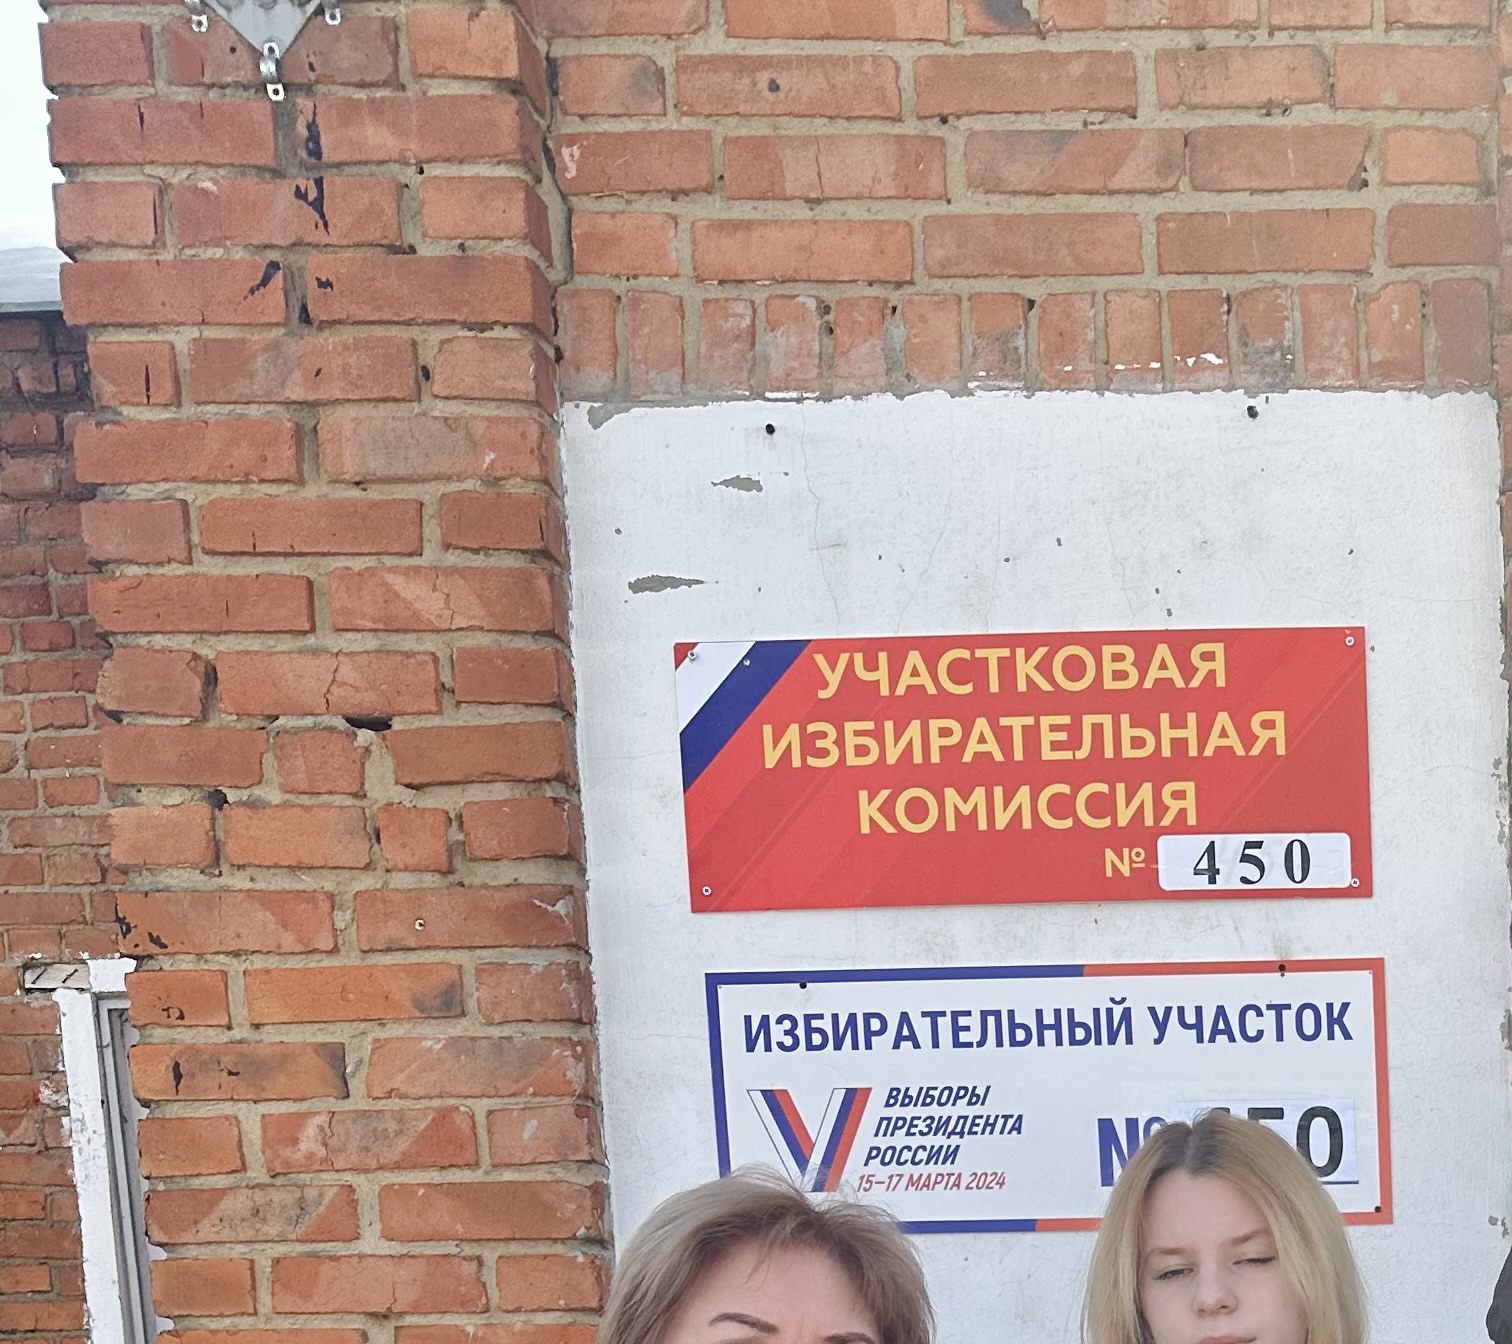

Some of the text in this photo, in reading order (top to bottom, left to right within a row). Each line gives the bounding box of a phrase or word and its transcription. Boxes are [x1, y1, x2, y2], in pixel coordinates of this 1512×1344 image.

[812, 642, 1226, 699] УЧАСТКОВАЯ
[762, 710, 1286, 769] ИЗБИРАТЕЛЬНАЯ
[857, 781, 1196, 834] КОМИССИЯ
[1104, 838, 1310, 886] № 450
[743, 996, 1354, 1053] ИЗБИРАТЕЛЬНЫЙ УЧАСТОК
[884, 1085, 991, 1108] ВЫБОРЫ
[874, 1114, 1023, 1139] ПРЕЗИДЕНТА
[863, 1144, 961, 1166] РОССИИ
[905, 1172, 962, 1191] МАРТА
[965, 1172, 1006, 1191] 2024
